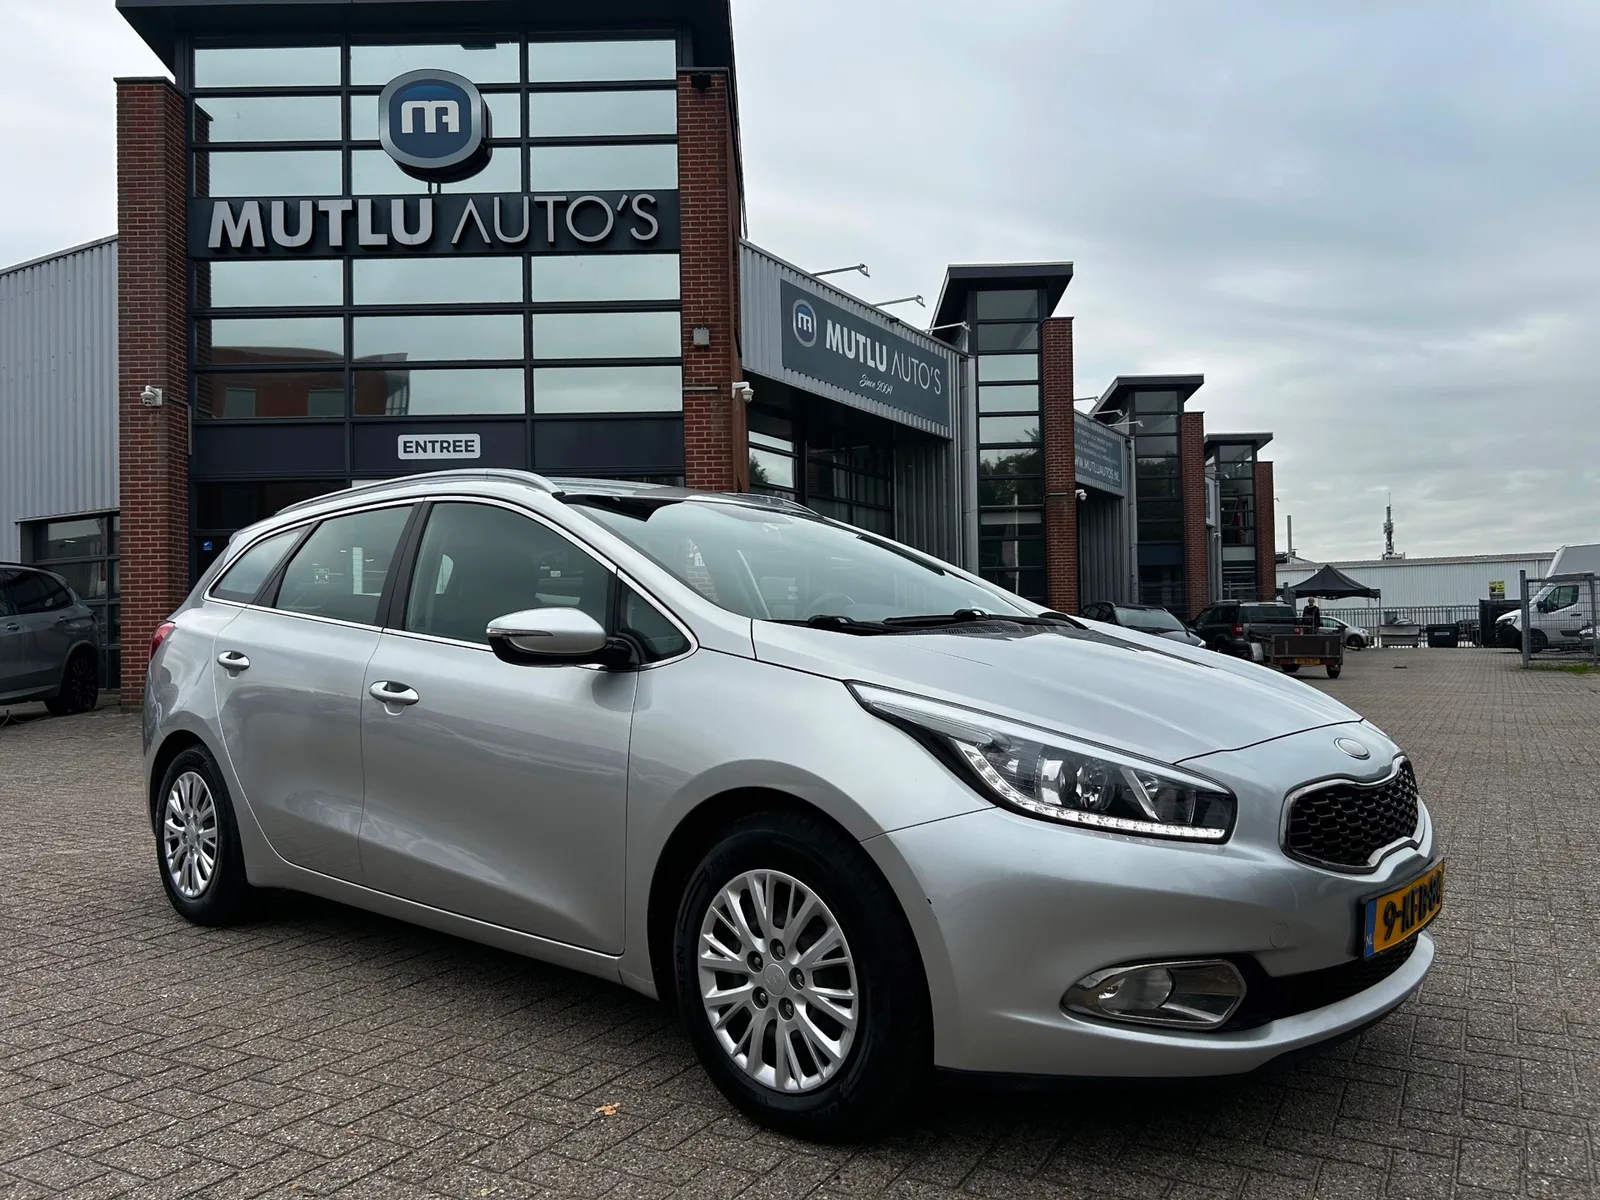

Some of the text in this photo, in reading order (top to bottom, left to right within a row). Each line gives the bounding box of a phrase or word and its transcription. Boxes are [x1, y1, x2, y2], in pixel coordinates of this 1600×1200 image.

[207, 193, 659, 249] MUTLU AUTO'S
[826, 319, 942, 395] MUTLU AUTO'S
[403, 440, 475, 454] ENTREE
